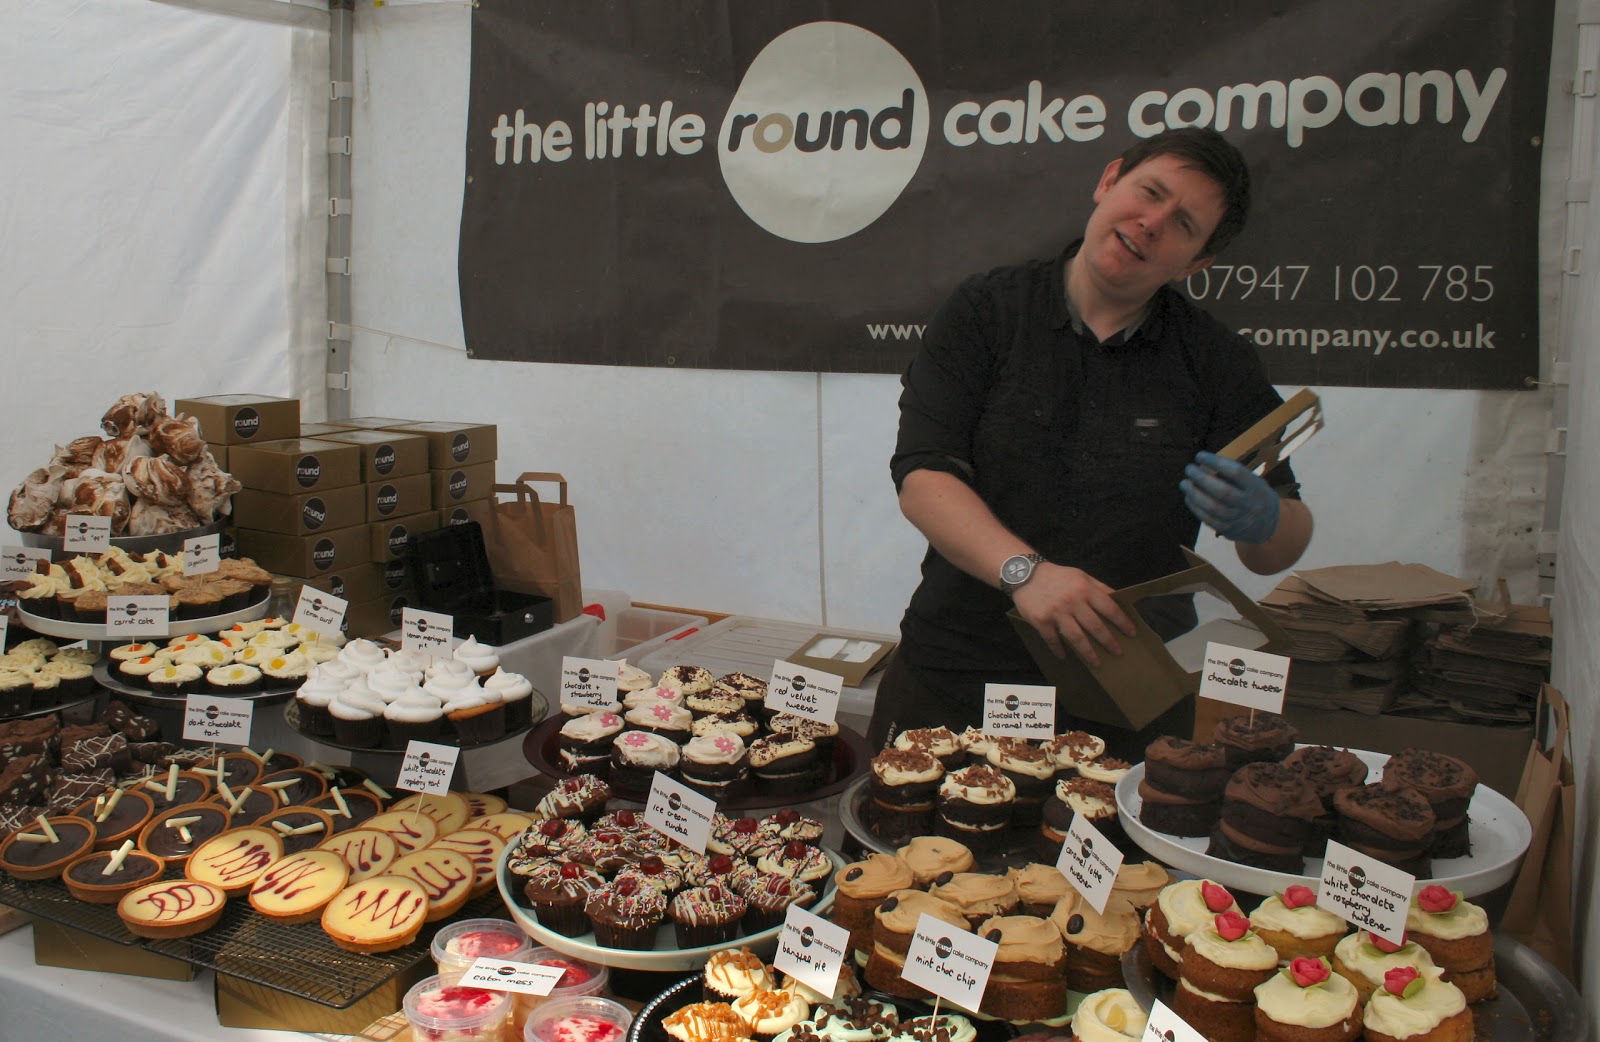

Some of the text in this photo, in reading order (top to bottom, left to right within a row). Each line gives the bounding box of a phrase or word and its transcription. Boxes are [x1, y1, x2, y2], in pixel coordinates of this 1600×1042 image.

[492, 68, 1506, 164] the little round cake company
[1187, 265, 1494, 301] 07947 102 785
[235, 416, 258, 426] round
[453, 440, 468, 453] round
[375, 453, 394, 464] round
[297, 467, 319, 475] round
[450, 479, 466, 490] round
[377, 494, 397, 504] round
[304, 505, 325, 521] round
[389, 535, 407, 545] round
[221, 543, 234, 553] und
[314, 548, 334, 558] round
[304, 609, 318, 618] lemon
[1208, 672, 1248, 688] chocolate
[1260, 670, 1284, 679] company
[565, 681, 591, 689] chocolate
[818, 687, 837, 695] company
[571, 691, 601, 700] strawberry
[775, 687, 817, 703] red velvet
[786, 701, 818, 713] tweener
[988, 711, 1020, 719] chocolate
[208, 720, 241, 728] chocolate
[884, 721, 897, 749] pany
[404, 764, 445, 775] white chocolate
[653, 804, 687, 822] ice cream
[692, 810, 710, 822] company
[665, 821, 688, 836] sundae
[1066, 847, 1086, 868] caramel
[1070, 865, 1092, 888] tweener
[1336, 864, 1347, 874] little
[1349, 871, 1365, 883] round
[1367, 879, 1379, 889] cake
[1381, 885, 1407, 902] company
[1324, 876, 1395, 912] white chocolate
[1333, 894, 1370, 916] raspberry
[1352, 911, 1391, 932] tweener
[814, 938, 822, 946] cake
[824, 943, 841, 957] company
[926, 936, 935, 945] little
[937, 943, 952, 953] round
[953, 949, 964, 959] cake
[965, 955, 988, 970] company
[815, 961, 826, 971] pie
[916, 956, 975, 990] mint choc chip
